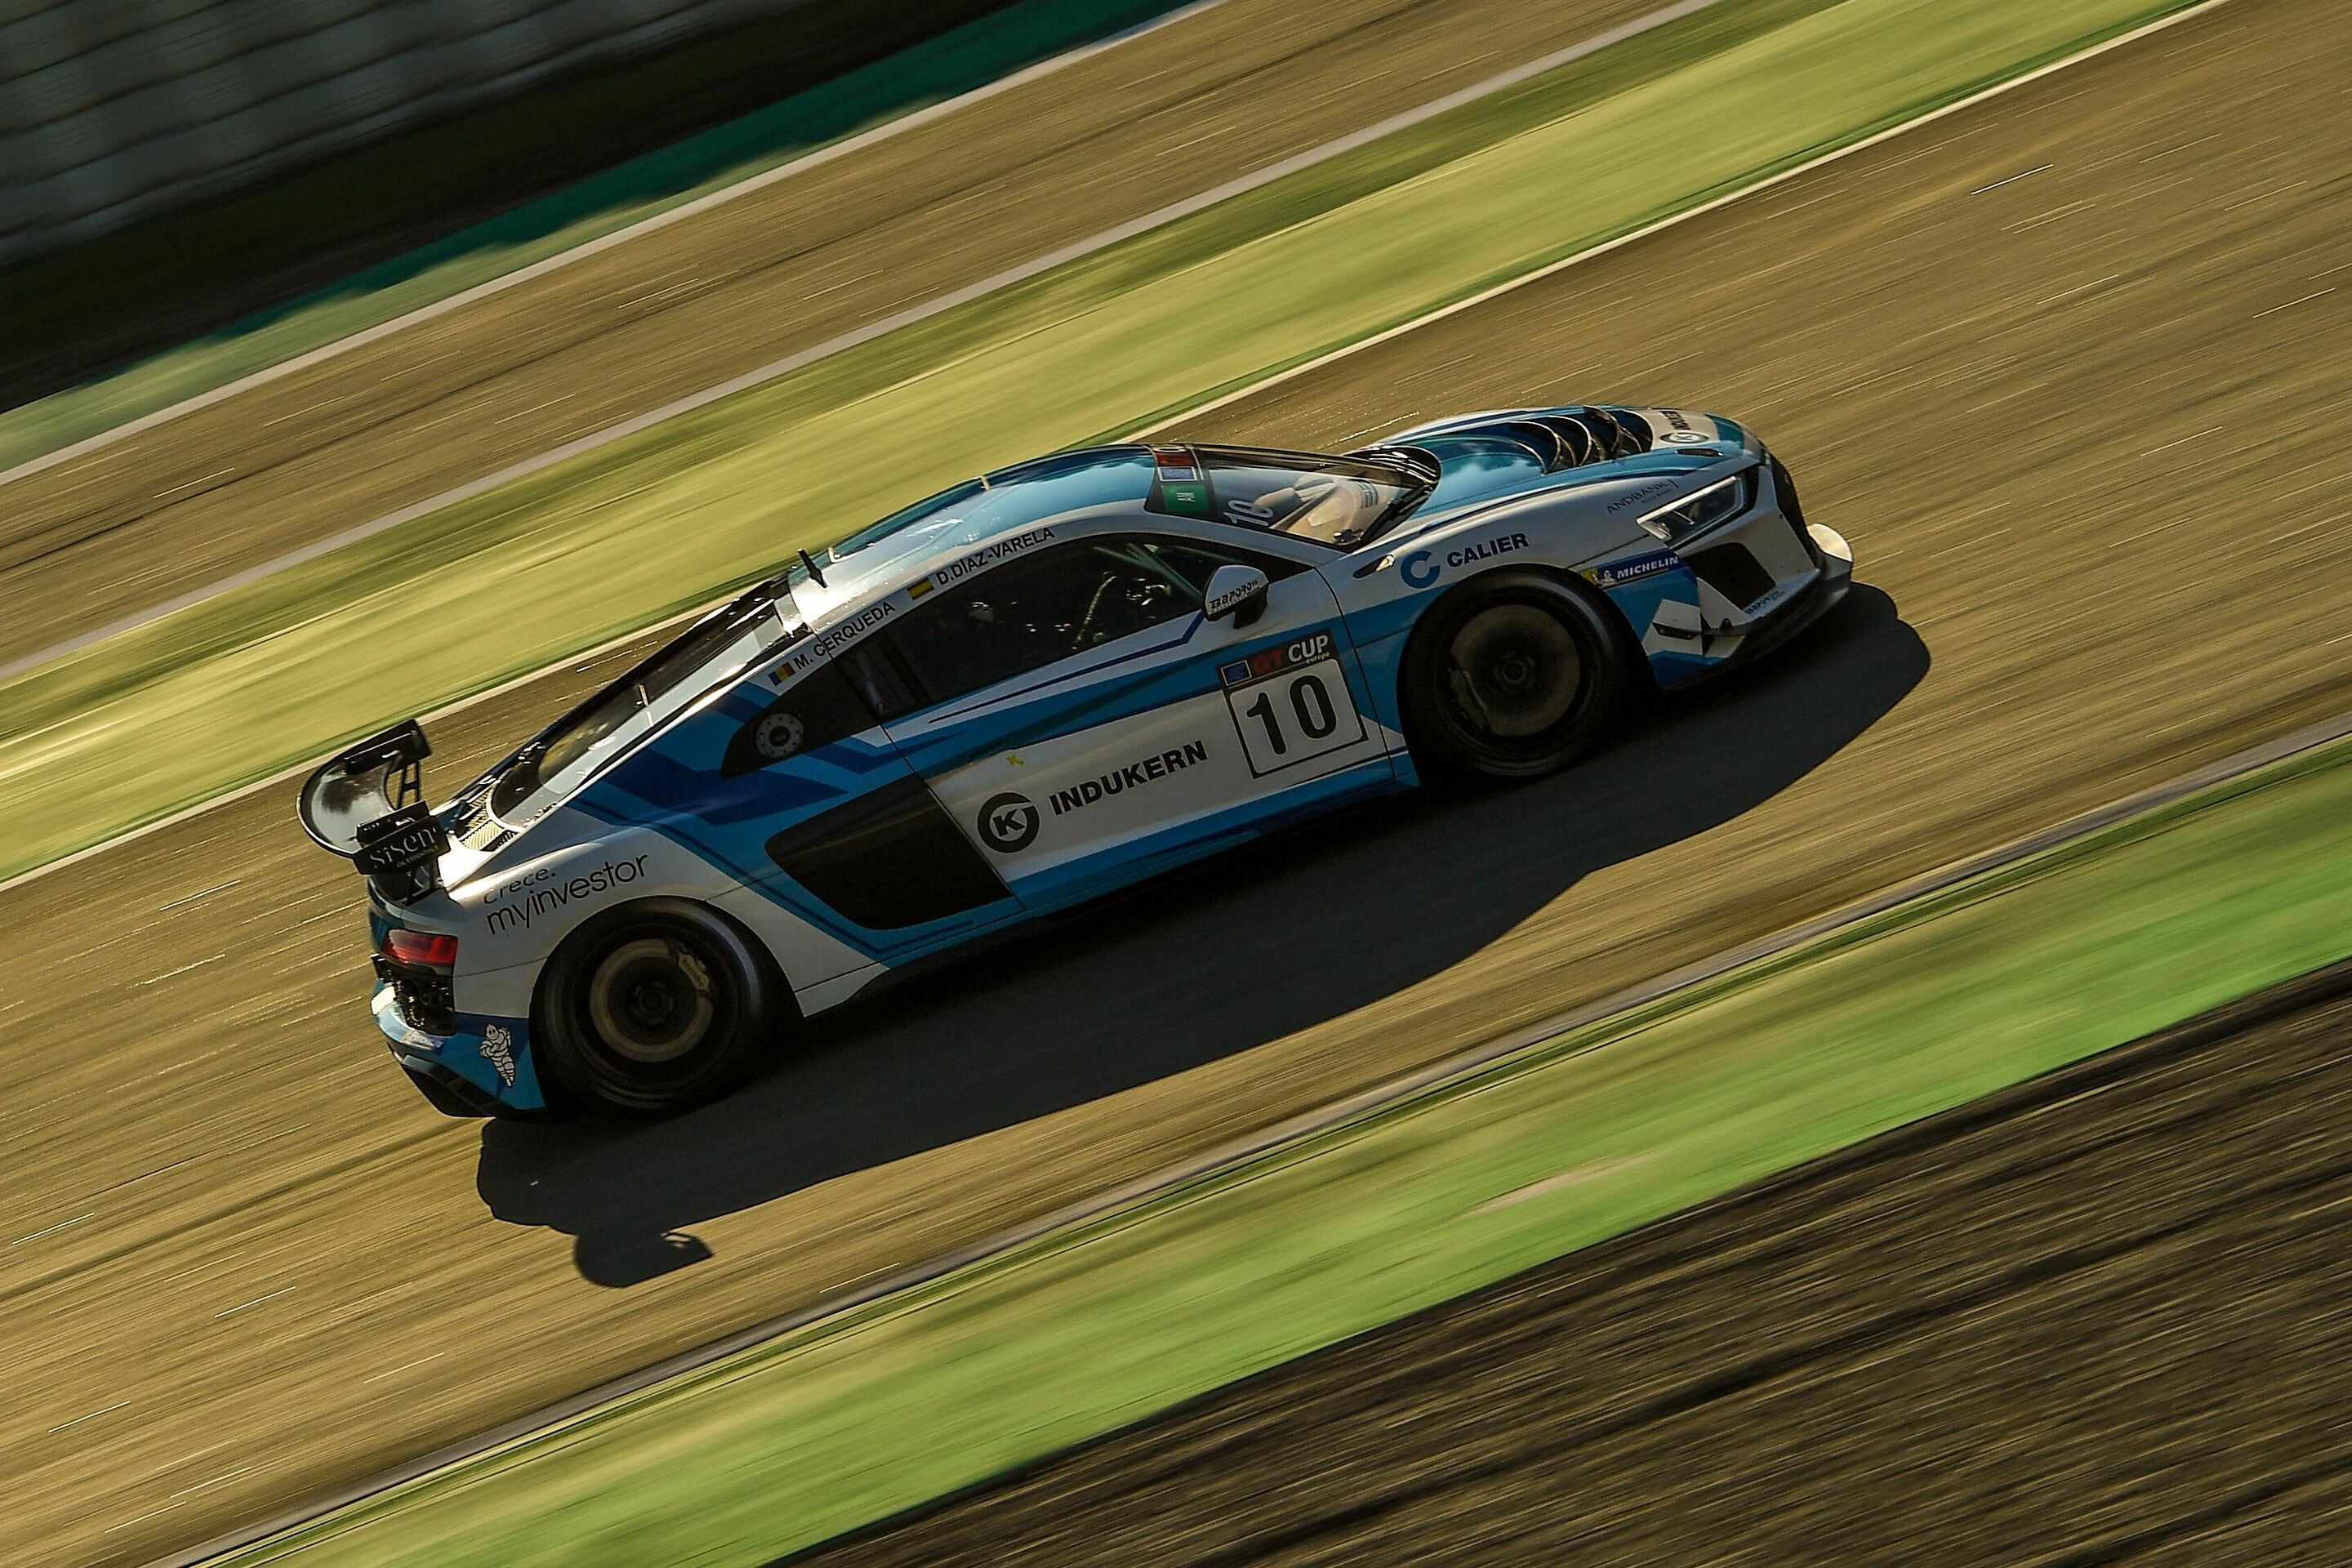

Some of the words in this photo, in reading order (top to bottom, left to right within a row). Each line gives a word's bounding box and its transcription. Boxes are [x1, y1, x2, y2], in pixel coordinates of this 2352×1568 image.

[1223, 499, 1273, 527] 10
[1446, 532, 1530, 568] CALIER
[1617, 555, 1679, 579] MICHELIN
[793, 653, 814, 670] M.
[813, 601, 897, 657] CERQUEDA
[1253, 648, 1286, 675] GT
[1288, 635, 1329, 662] CUP
[1246, 675, 1337, 755] 10
[1048, 739, 1208, 816] INDUKERN
[487, 854, 648, 935] myinvestor
